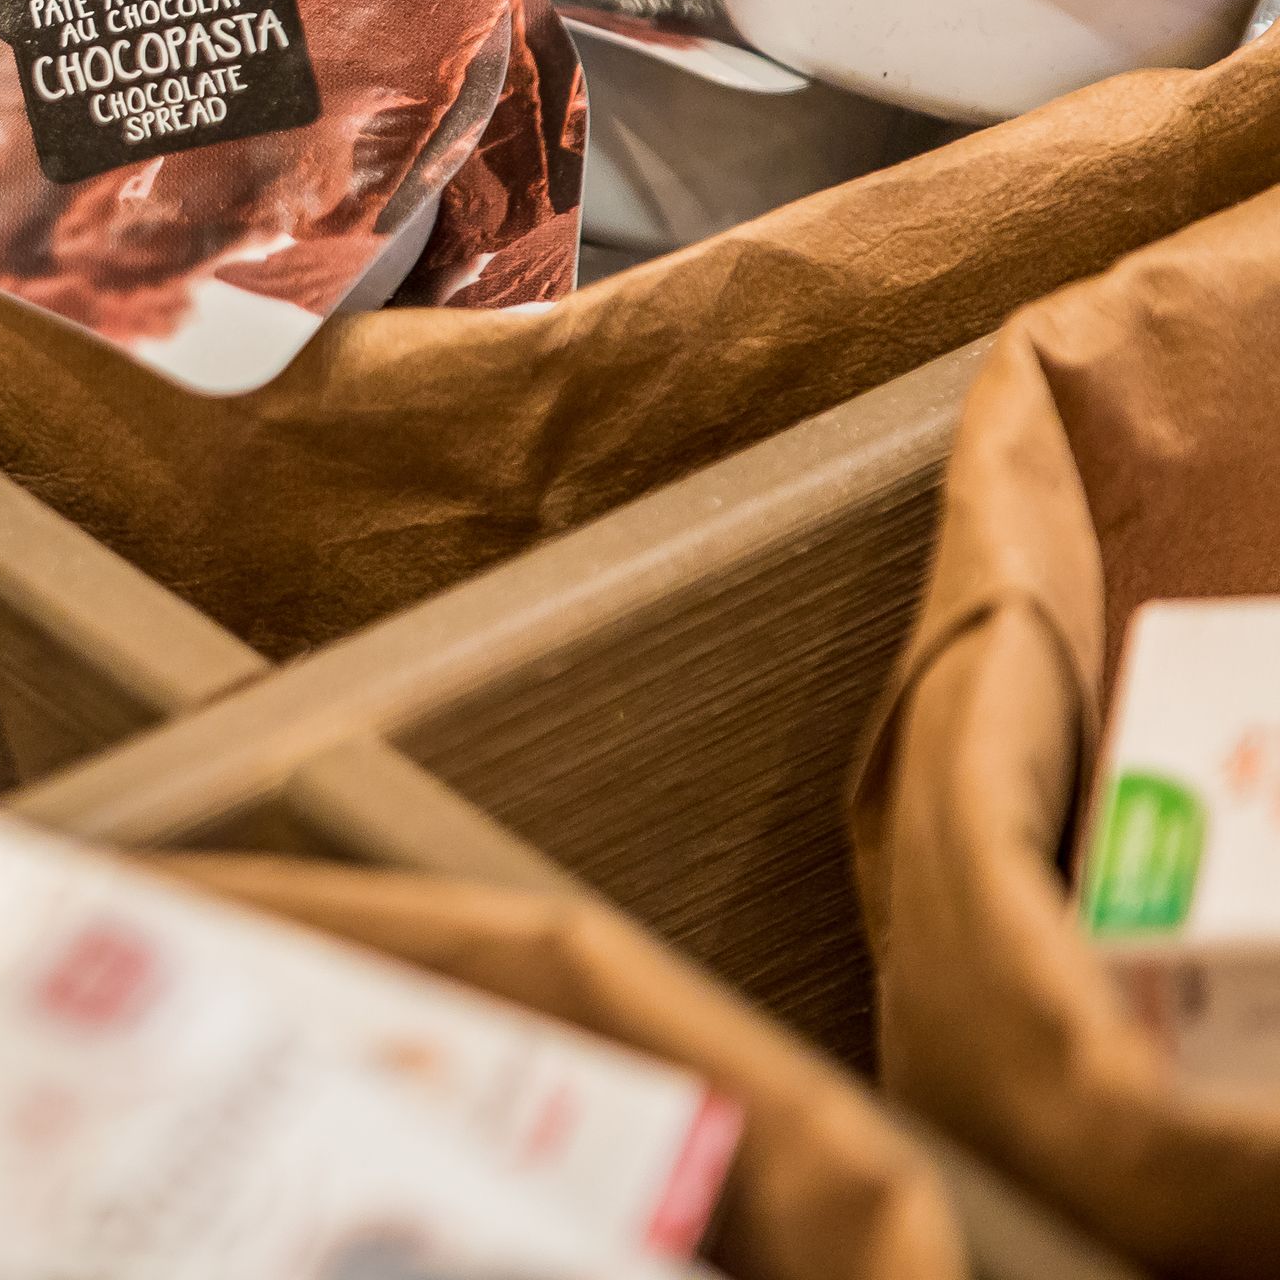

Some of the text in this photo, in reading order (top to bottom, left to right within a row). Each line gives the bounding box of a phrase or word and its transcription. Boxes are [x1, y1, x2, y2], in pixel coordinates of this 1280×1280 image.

[32, 8, 290, 101] CHOCOPASTA
[60, 18, 100, 48] AU
[91, 64, 249, 124] CHOCOLATE
[124, 96, 228, 143] SPREAD
